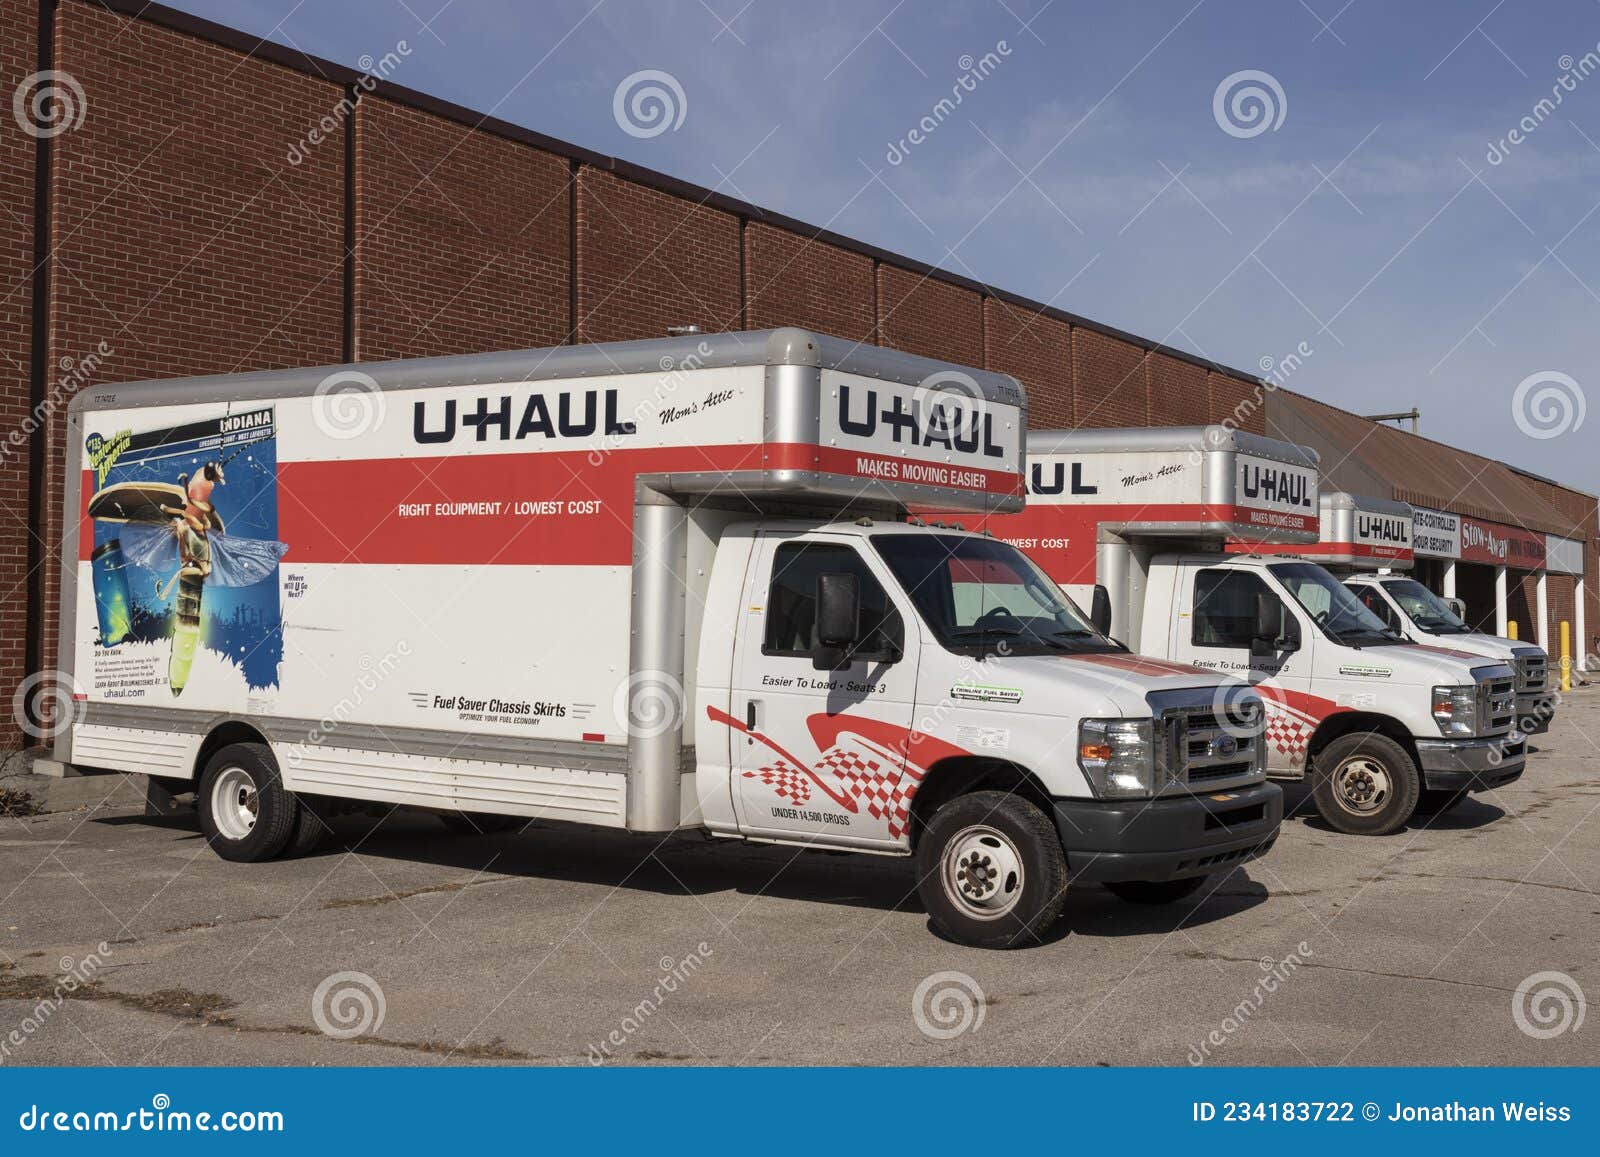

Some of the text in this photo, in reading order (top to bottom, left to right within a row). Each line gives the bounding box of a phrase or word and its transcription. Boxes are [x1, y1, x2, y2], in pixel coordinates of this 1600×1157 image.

[659, 402, 698, 425] Mom's
[701, 389, 735, 411] Attic
[220, 411, 271, 433] INDIANA
[857, 457, 986, 489] MAKES MOVING EASIER
[1026, 462, 1185, 495] UL Mom's Attic
[399, 503, 431, 517] RIGHT
[435, 502, 501, 516] EQUIPMENT
[514, 501, 563, 515] LOWEST
[567, 500, 602, 514] COST
[1041, 538, 1070, 549] COST
[1193, 659, 1217, 669] Easier
[1220, 660, 1229, 670] To
[1231, 662, 1251, 670] Load
[1258, 663, 1281, 672] Seats
[1283, 664, 1290, 672] 3
[104, 688, 145, 698] uhaul.com
[762, 675, 794, 688] Easier
[797, 677, 808, 688] To
[811, 680, 837, 691] Load
[846, 681, 876, 693] Seats
[879, 683, 886, 694] 3
[999, 690, 1019, 698] SAVER
[433, 695, 566, 718] Fuel Saver Chassis Skirts
[459, 712, 540, 726] OPTIMIZE YOUR FUEL ECONOMY
[771, 807, 850, 826] UNDER 14,500 GROSS
